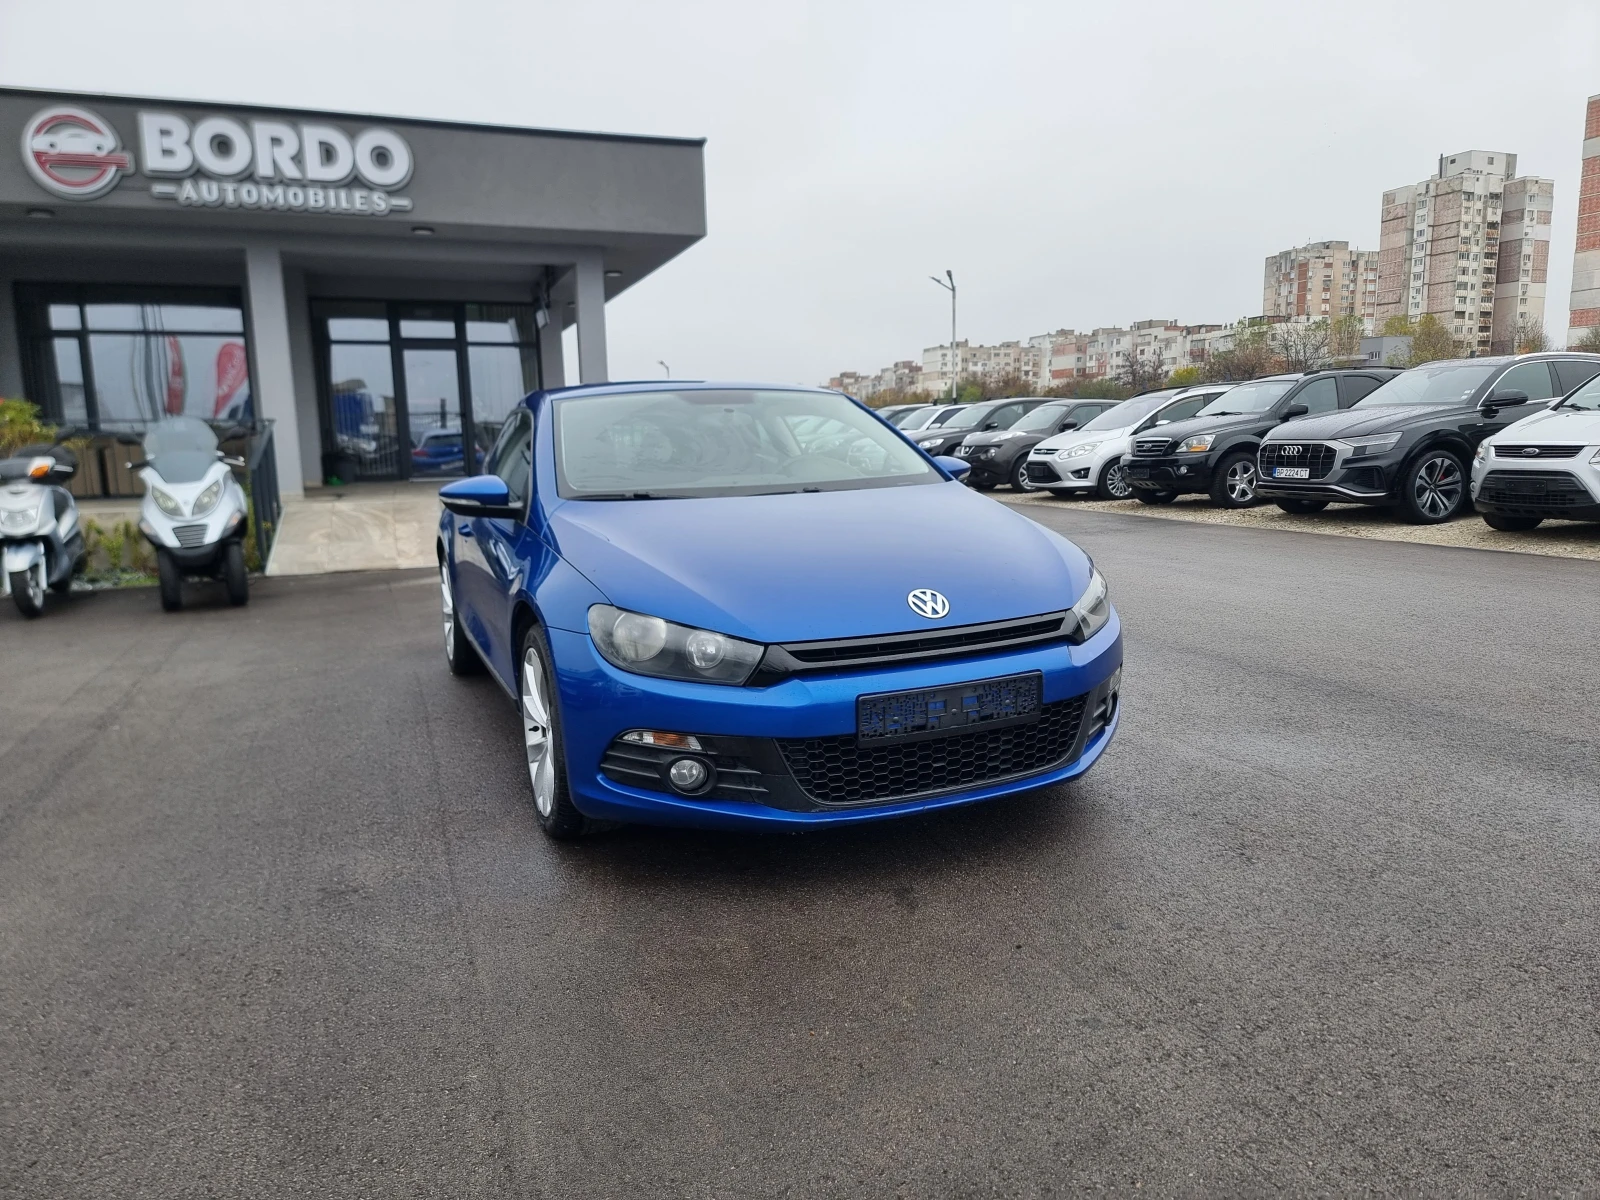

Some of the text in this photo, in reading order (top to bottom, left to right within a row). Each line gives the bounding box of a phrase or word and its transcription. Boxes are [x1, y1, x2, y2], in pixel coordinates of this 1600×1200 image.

[139, 112, 411, 186] BORDO
[180, 180, 388, 212] AUTOMOBILES
[1285, 468, 1298, 477] 2224
[908, 589, 949, 618] VW
